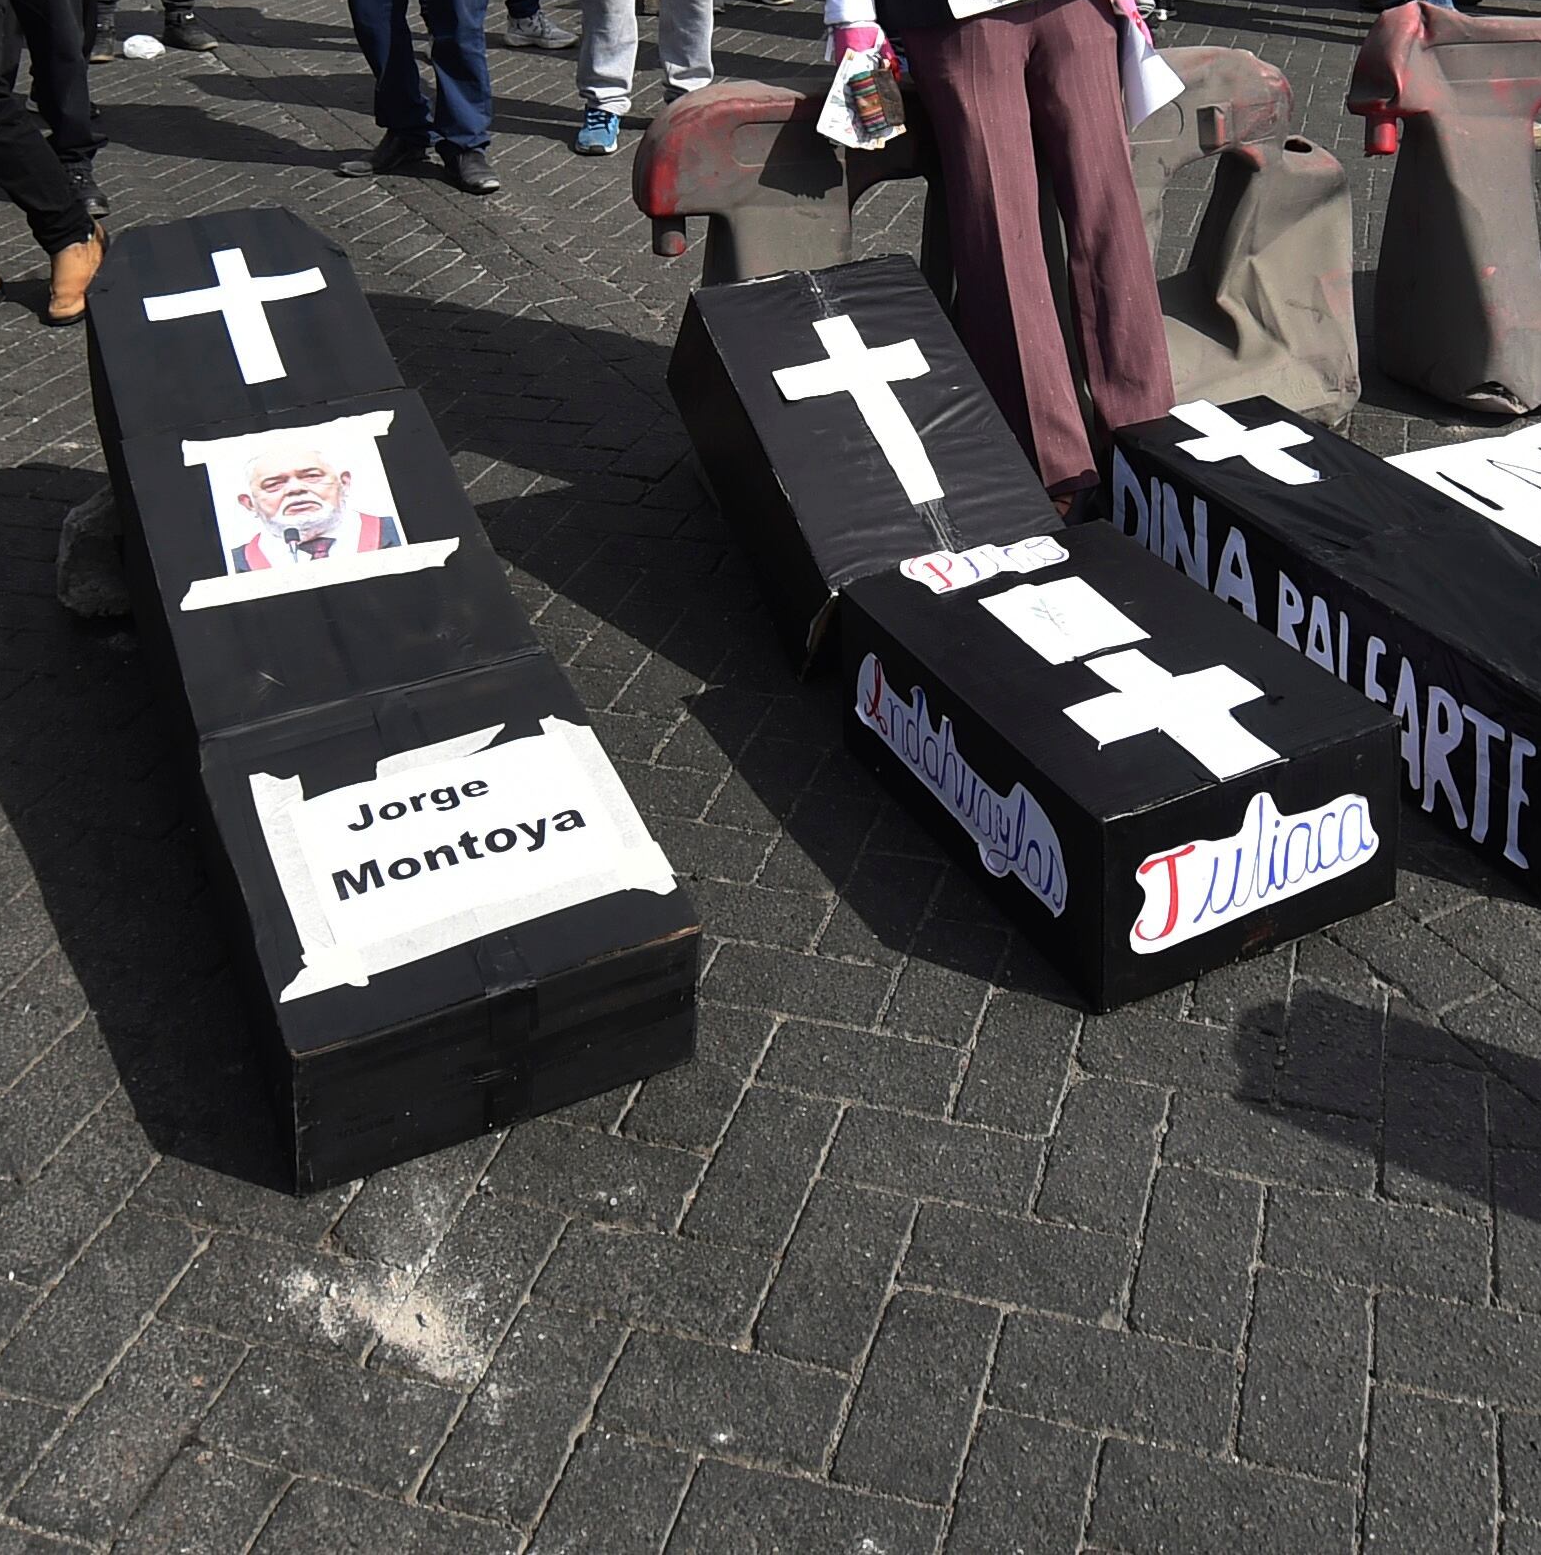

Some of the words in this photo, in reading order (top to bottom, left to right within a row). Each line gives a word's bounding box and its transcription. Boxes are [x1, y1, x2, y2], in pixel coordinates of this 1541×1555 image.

[1112, 444, 1258, 623] DINA
[331, 809, 587, 902] Montoya
[347, 780, 490, 832] Jorge
[1134, 795, 1375, 941] Juliaca
